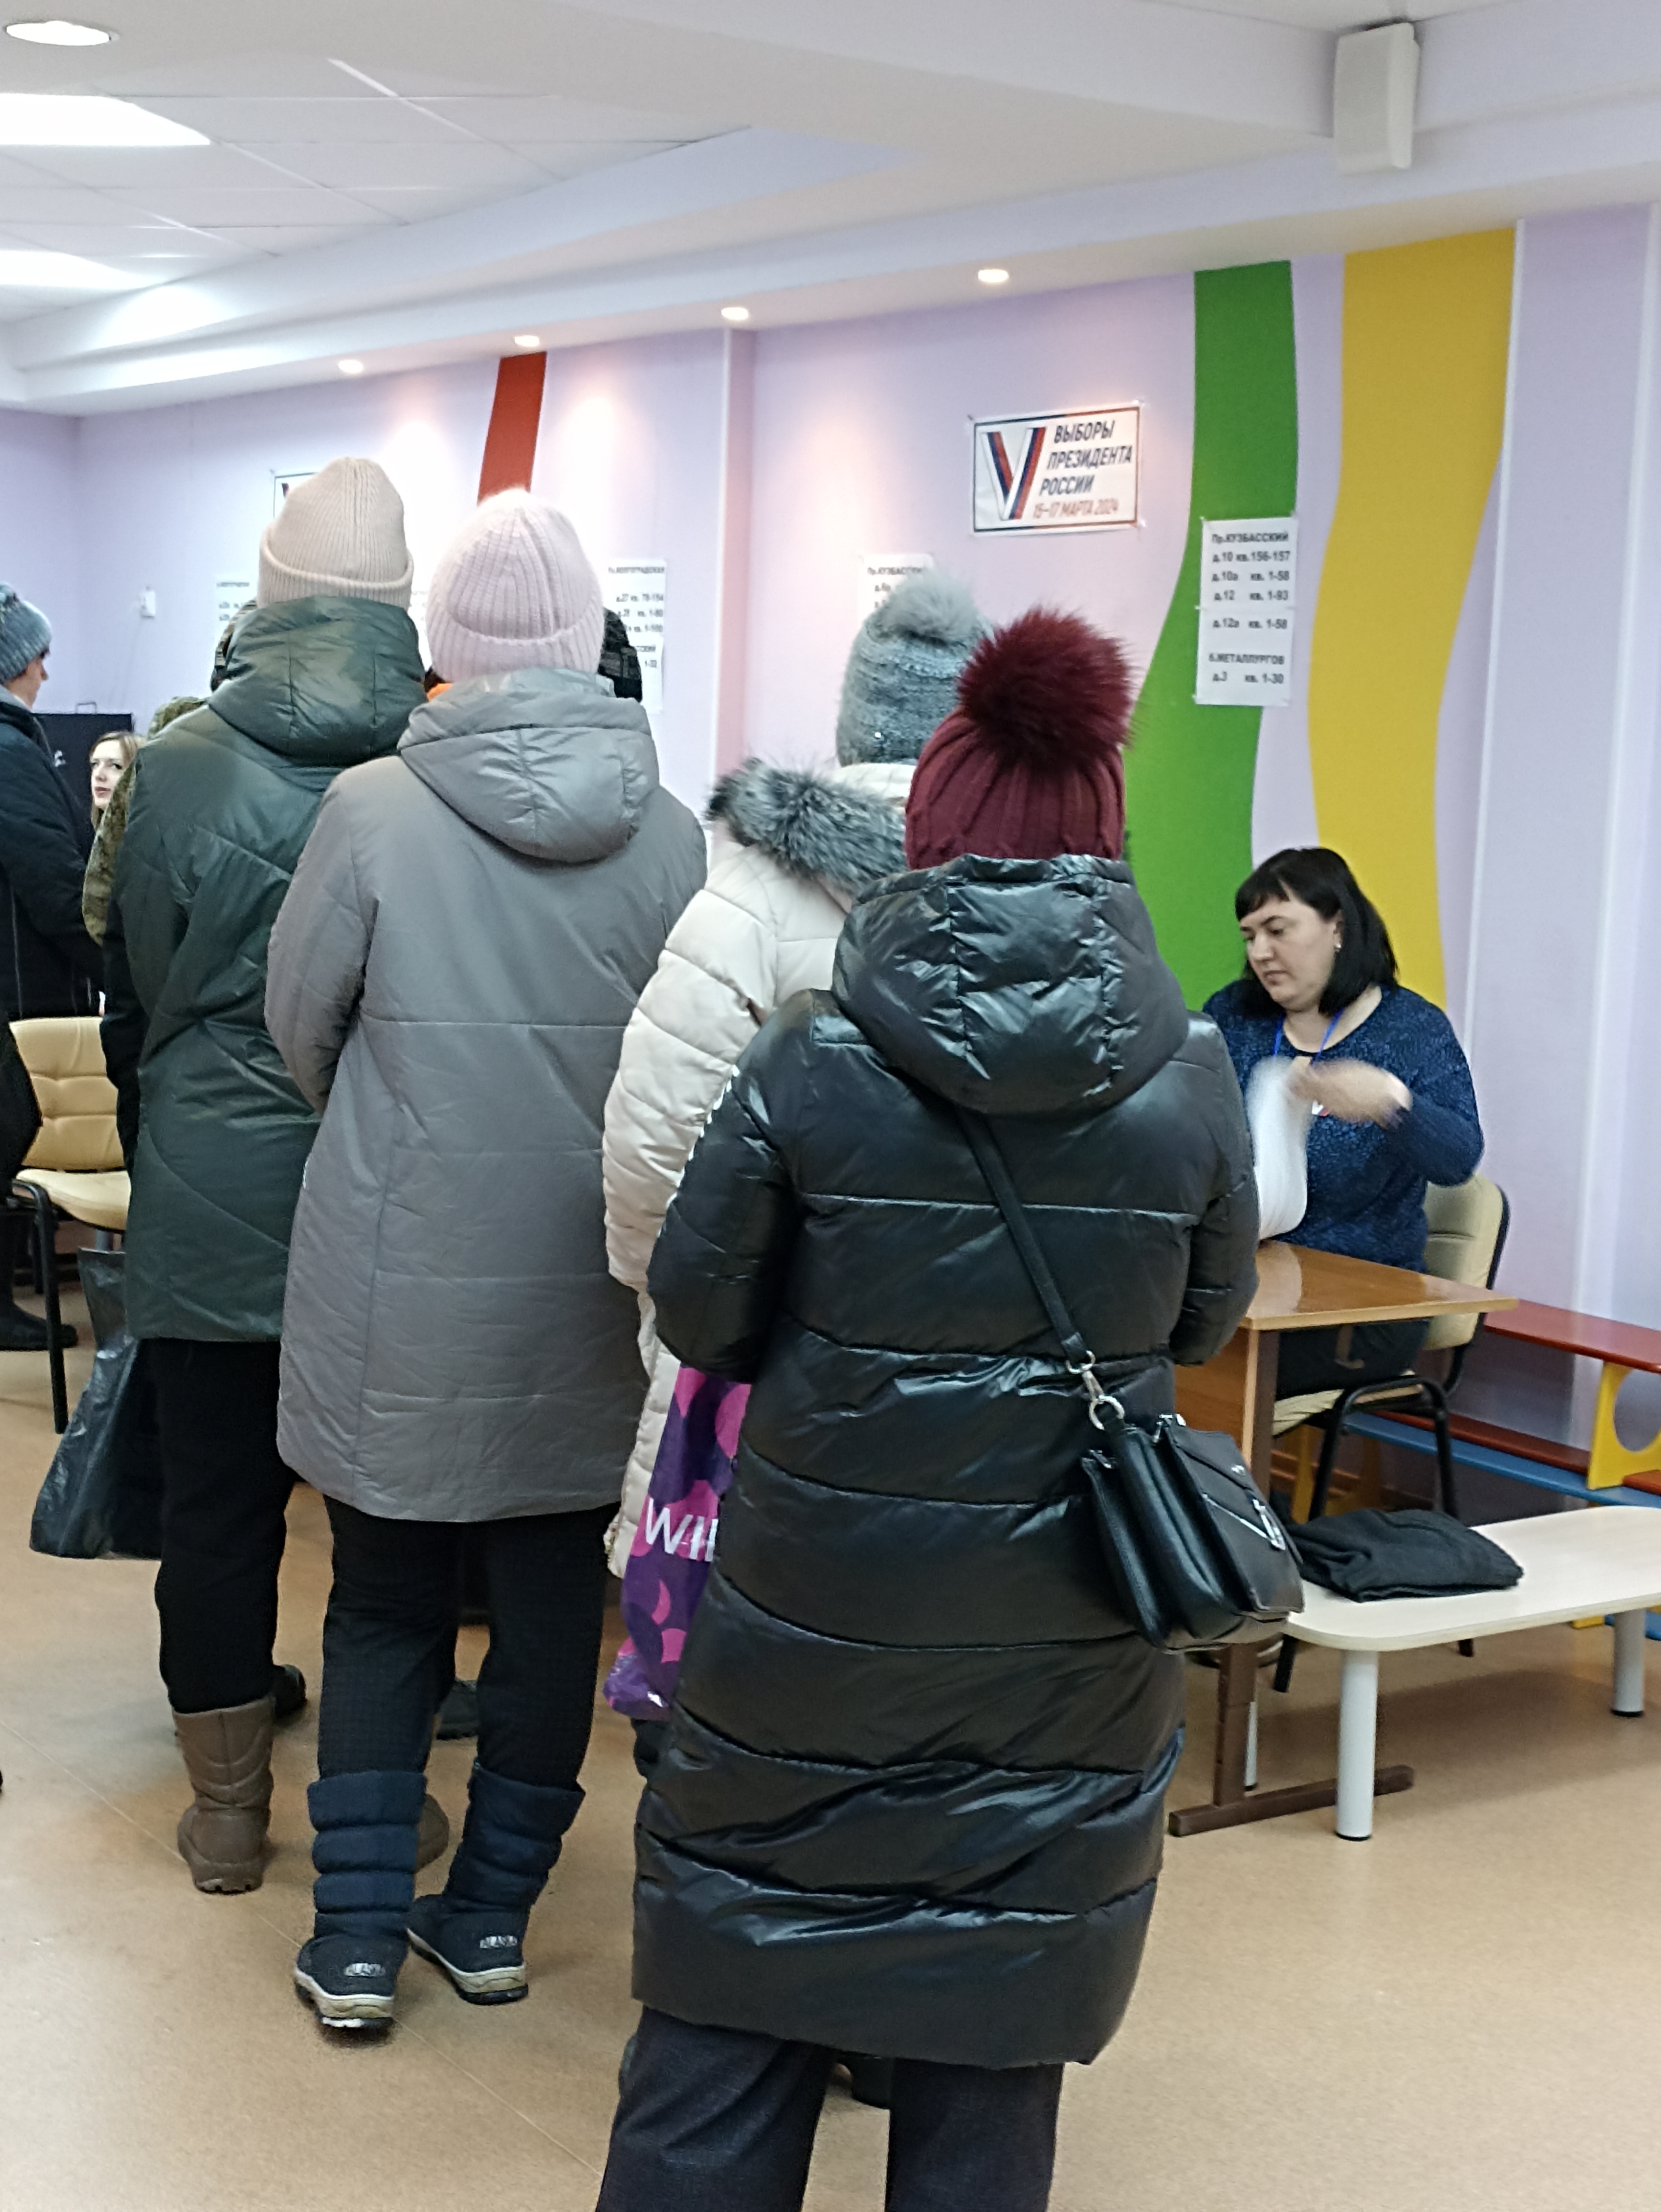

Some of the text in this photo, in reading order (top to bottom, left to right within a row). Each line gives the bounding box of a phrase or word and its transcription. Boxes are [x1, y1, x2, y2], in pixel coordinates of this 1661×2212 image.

[1054, 420, 1115, 443] ВЫБОРЫ
[1047, 445, 1133, 470] ПРЕЗИДЕНТА
[1039, 475, 1096, 496] РОССИИ
